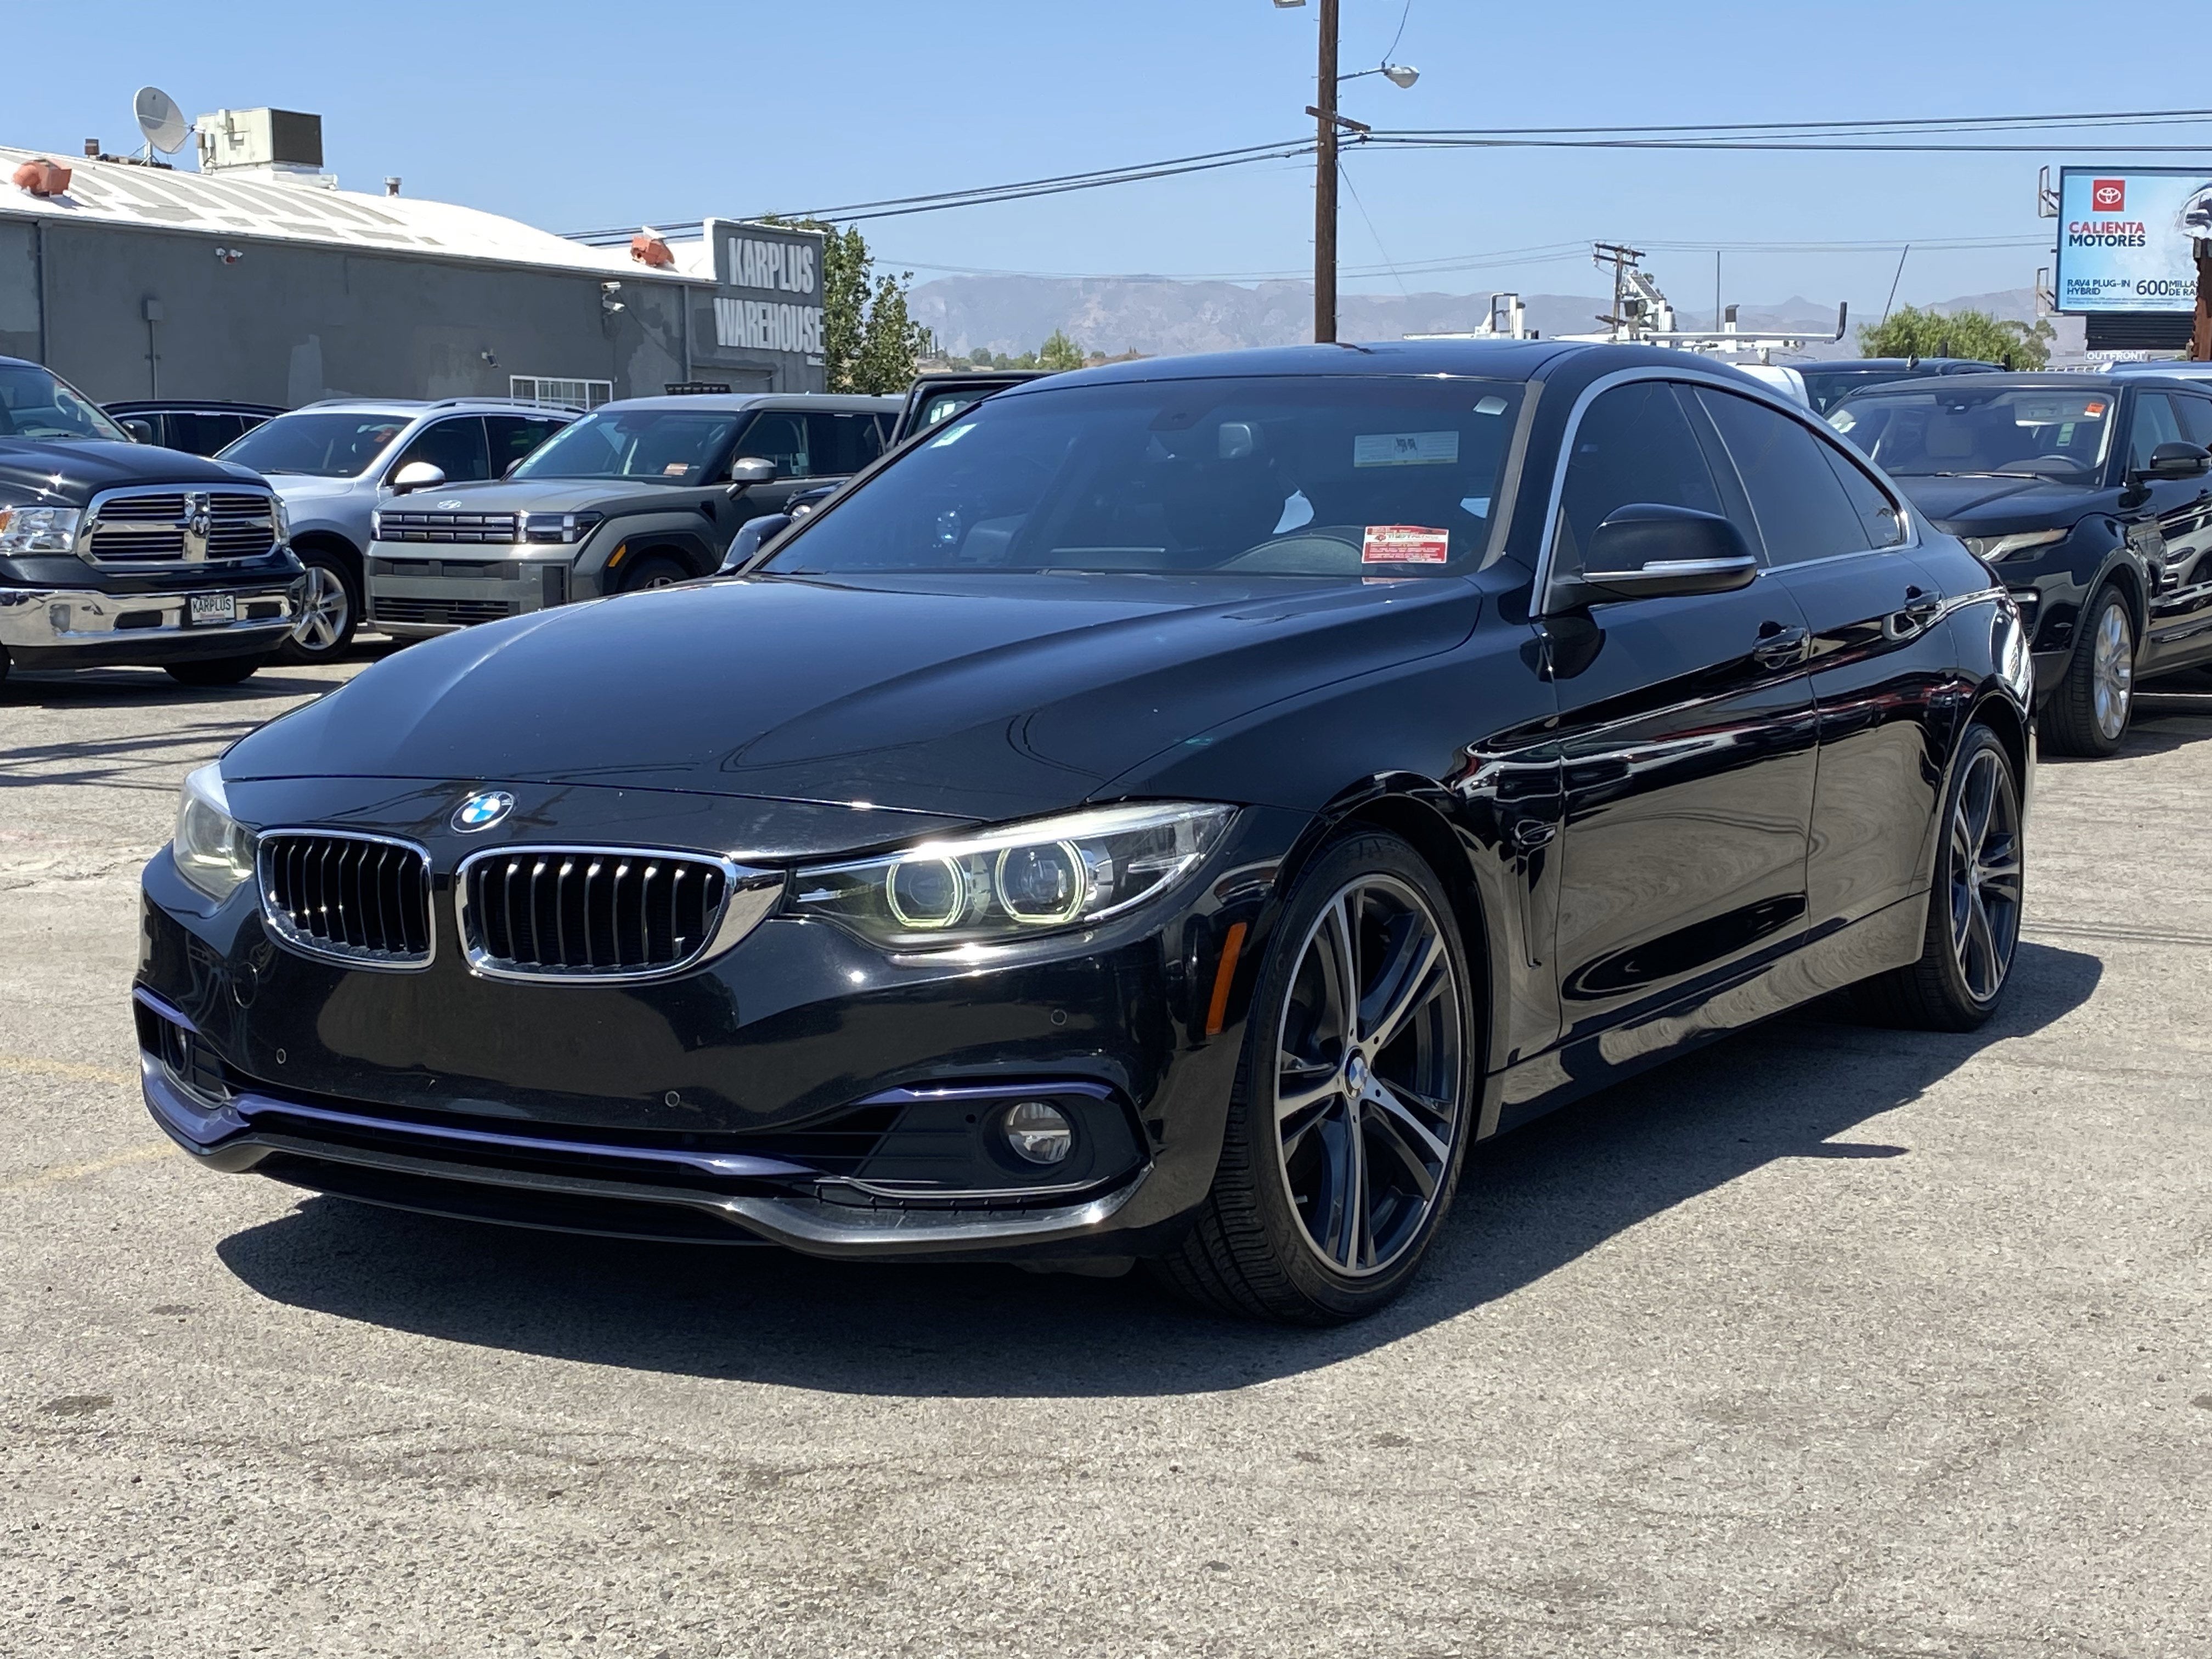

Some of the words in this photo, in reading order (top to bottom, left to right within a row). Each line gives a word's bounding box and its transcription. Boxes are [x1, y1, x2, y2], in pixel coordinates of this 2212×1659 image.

[2069, 221, 2145, 234] CALIENTA
[2069, 234, 2146, 247] MOTORES
[728, 237, 814, 294] KARPLUS
[2092, 279, 2130, 287] PLUG-IN
[2136, 280, 2168, 295] 600
[713, 298, 825, 353] WAREHOUSE
[2087, 351, 2146, 360] OUTFRONT
[193, 599, 232, 613] KARPLUS
